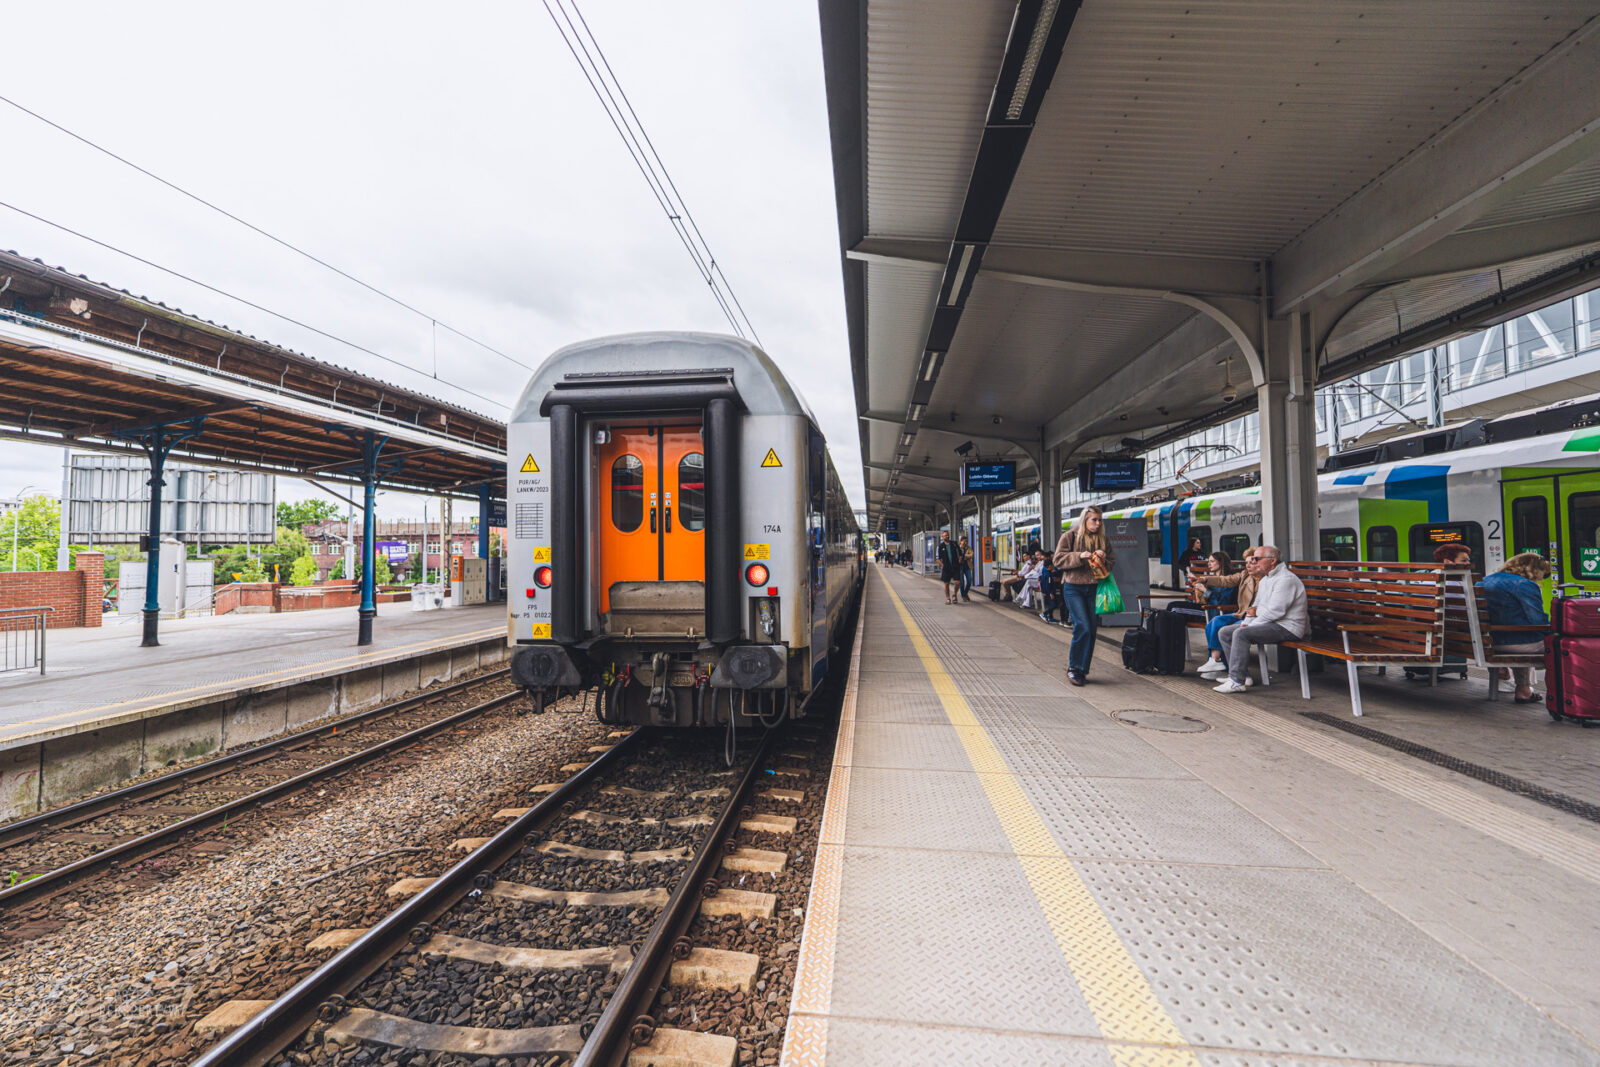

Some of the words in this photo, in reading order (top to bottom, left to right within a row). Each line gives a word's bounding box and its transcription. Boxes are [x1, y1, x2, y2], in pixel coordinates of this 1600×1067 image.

[1230, 513, 1262, 526] Pomorz
[763, 524, 782, 534] 174A
[1487, 519, 1501, 540] 2
